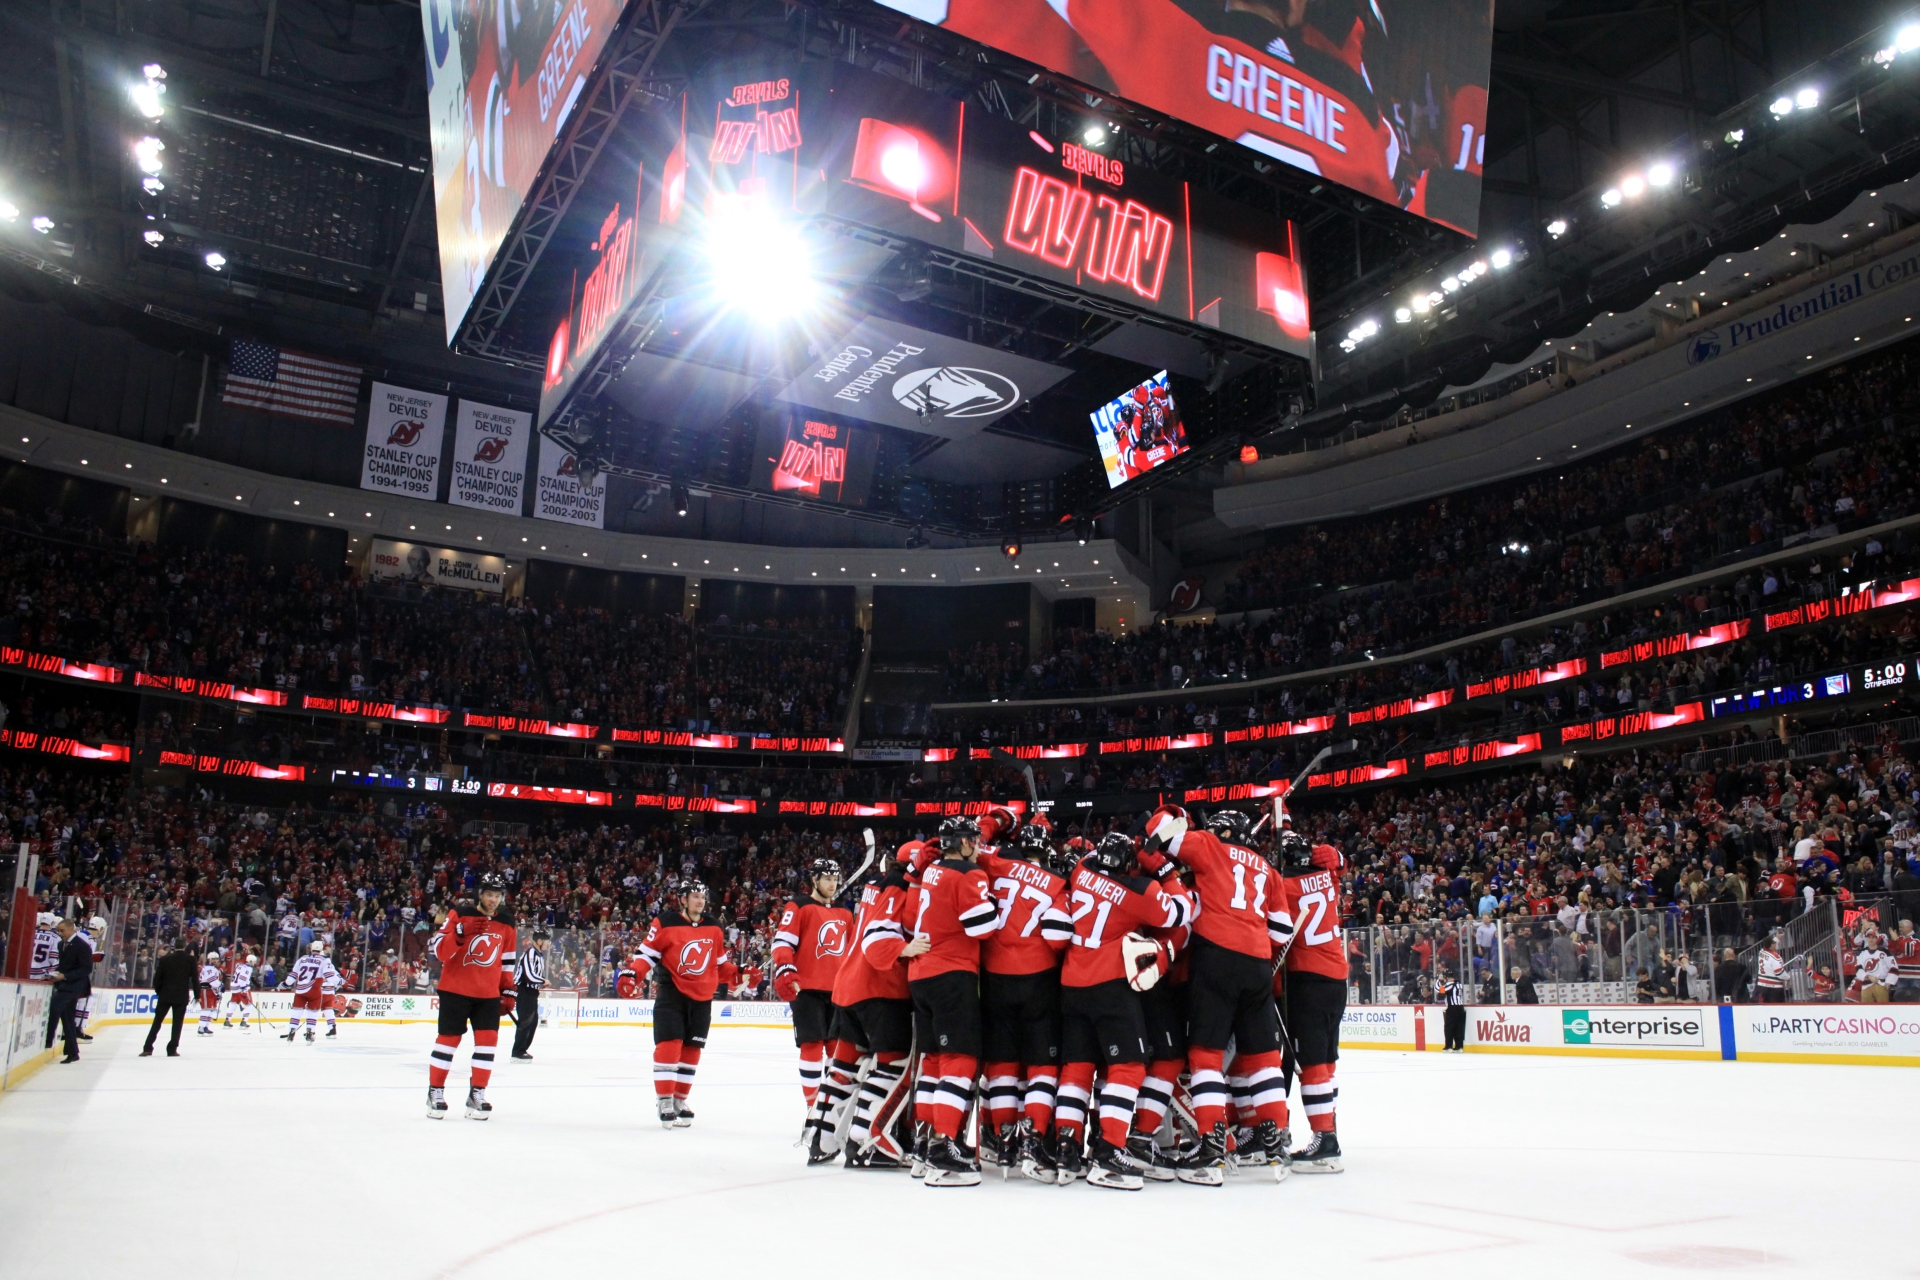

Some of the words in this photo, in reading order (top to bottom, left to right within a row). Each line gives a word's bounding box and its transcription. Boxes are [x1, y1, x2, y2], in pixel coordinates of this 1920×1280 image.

[538, 0, 592, 122] GREENE
[731, 79, 790, 107] DEVILS
[1206, 44, 1347, 153] GREENE
[708, 108, 803, 164] WIN
[1062, 142, 1125, 187] DEVILS
[1004, 167, 1174, 301] WIN
[1728, 273, 1863, 348] Prudential
[1867, 250, 1920, 290] Cen
[814, 345, 872, 383] Center
[833, 341, 925, 403] Prudential
[386, 393, 404, 405] NEW
[405, 396, 433, 409] JERSEY
[389, 403, 428, 420] DEVILS
[472, 410, 489, 421] NEW
[490, 413, 517, 425] JERSEY
[475, 419, 512, 436] DEVILS
[367, 445, 412, 464] STANLEY
[415, 454, 437, 468] CUP
[778, 440, 845, 482] WIN
[368, 459, 433, 483] CHAMPIONS
[455, 460, 499, 480] STANLEY
[502, 470, 523, 484] CUP
[369, 475, 430, 494] 1994-1995
[456, 476, 518, 498] CHAMPIONS
[539, 476, 582, 495] STANLEY
[458, 491, 514, 509] 1999-2000
[540, 491, 600, 512] CHAMPIONS
[541, 504, 597, 522] 2002-2003
[374, 553, 400, 567] 1982
[439, 558, 452, 569] DR.
[454, 561, 473, 571] JOHN
[474, 563, 480, 571] J.
[438, 566, 500, 585] McMULLEN
[1865, 663, 1906, 683] 5:00
[1803, 682, 1813, 699] 3
[861, 738, 922, 747] stand
[407, 777, 416, 789] 3
[452, 779, 481, 791] 5:00
[510, 786, 519, 796] 4
[1102, 855, 1111, 865] 21
[1230, 847, 1269, 876] BOYLE
[1008, 862, 1051, 890] ZACHA
[978, 881, 989, 900] 2
[1076, 870, 1127, 905] PALMIERI
[1231, 864, 1267, 918] 11
[886, 897, 895, 915] 1
[914, 888, 932, 943] 2
[994, 877, 1053, 938] 37
[1071, 891, 1113, 949] 21
[33, 944, 50, 963] 5
[298, 965, 319, 981] 27
[556, 1006, 619, 1018] Prudential
[732, 1004, 786, 1018] HALMAR
[1342, 1013, 1363, 1022] EAST
[1366, 1012, 1397, 1023] COAST
[1342, 1027, 1371, 1036] POWER
[1373, 1027, 1378, 1036] &
[1380, 1028, 1398, 1037] GAS
[1477, 1019, 1532, 1043] Wawa
[1564, 1017, 1699, 1039] enterprise
